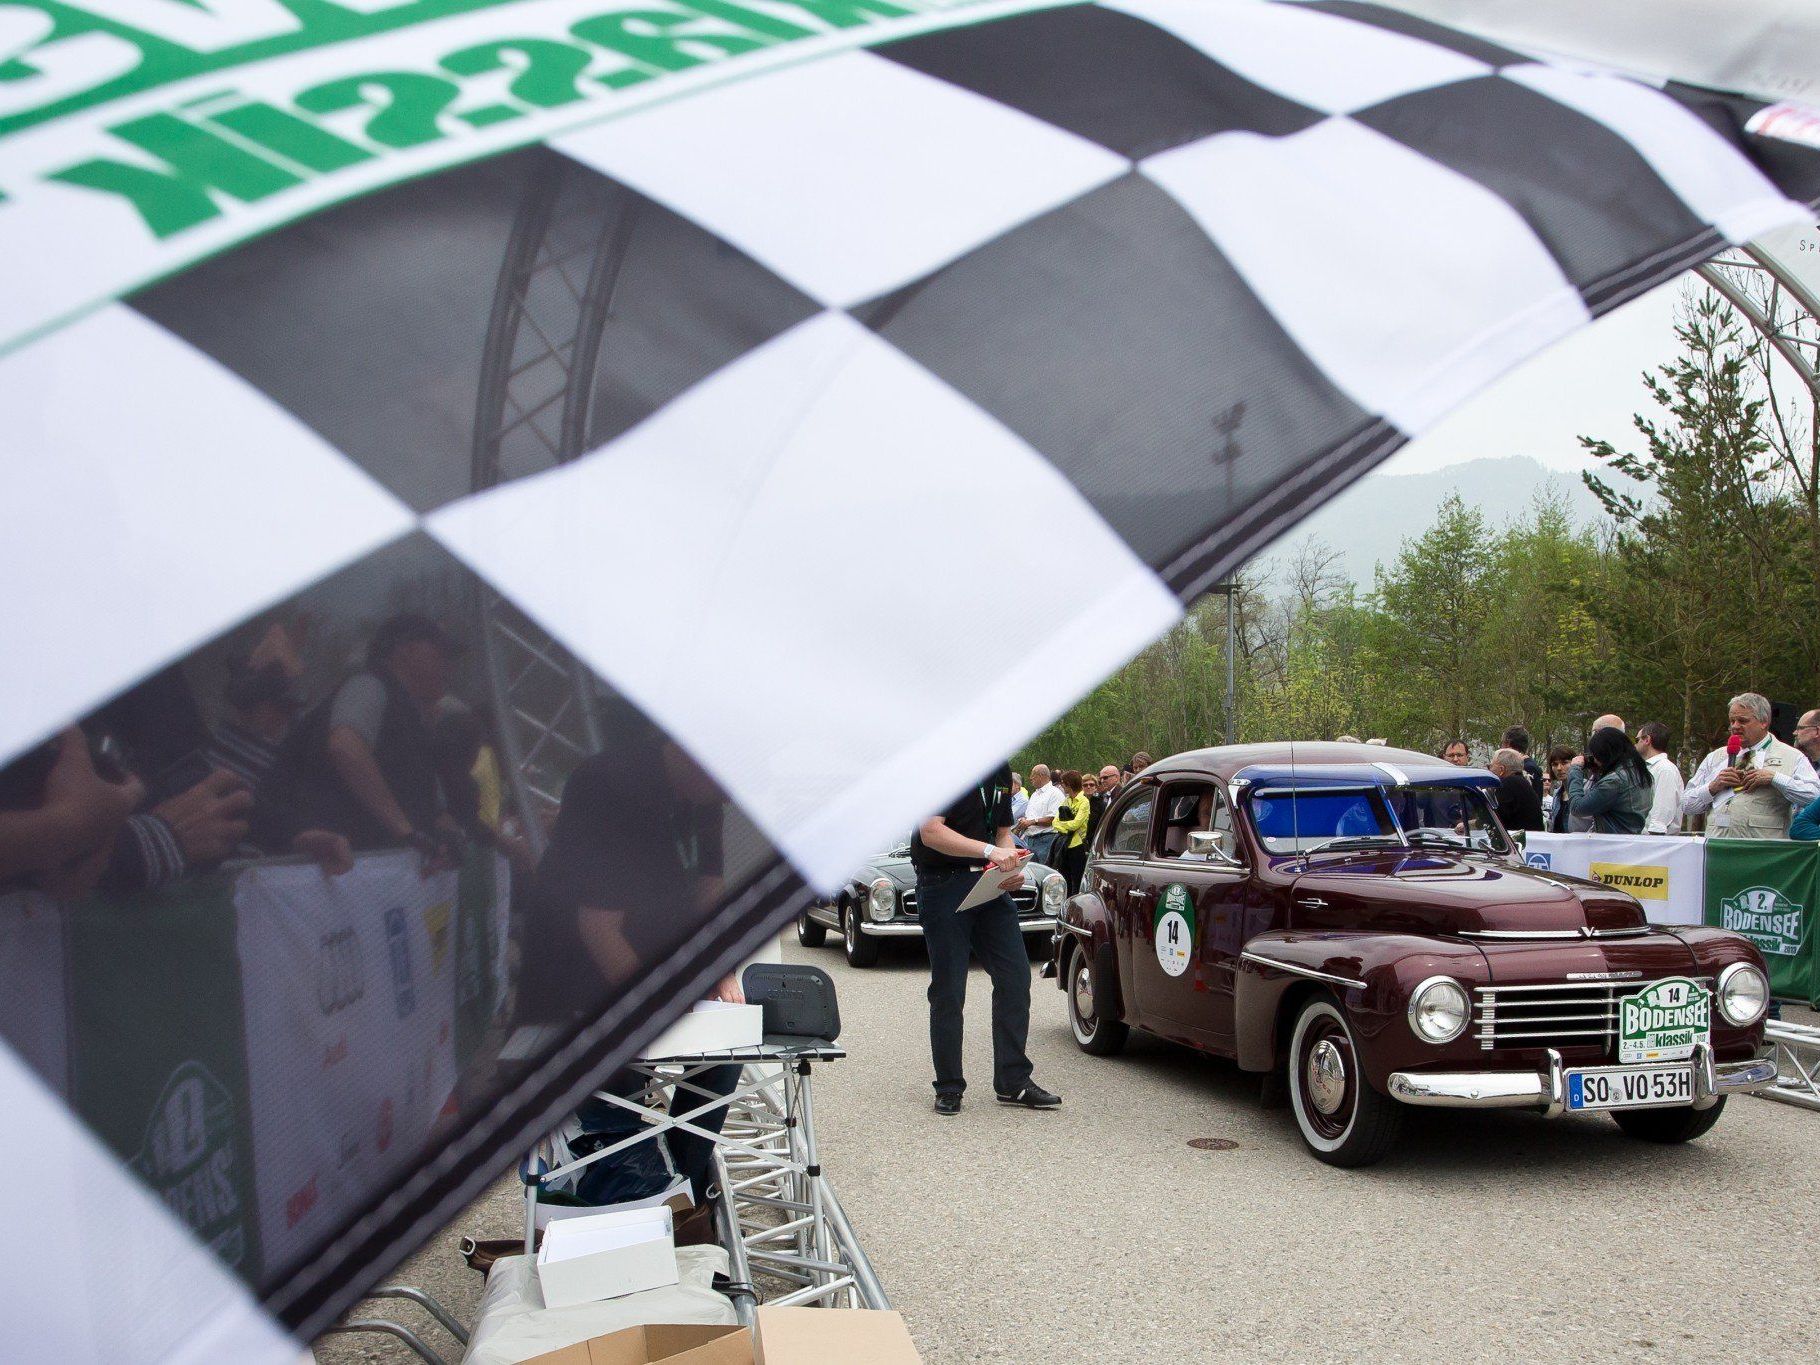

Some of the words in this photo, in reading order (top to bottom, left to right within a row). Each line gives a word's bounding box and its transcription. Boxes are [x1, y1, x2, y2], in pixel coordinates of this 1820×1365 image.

[1603, 874, 1664, 888] DUNLOP
[1167, 920, 1179, 945] 14
[1723, 904, 1800, 941] BODENSEE
[1668, 987, 1680, 1003] 14
[1625, 996, 1708, 1036] BODENSEE
[1655, 1030, 1693, 1048] klassik
[1583, 1076, 1609, 1103] SO
[1623, 1073, 1648, 1100] VO
[1653, 1071, 1690, 1099] 53H
